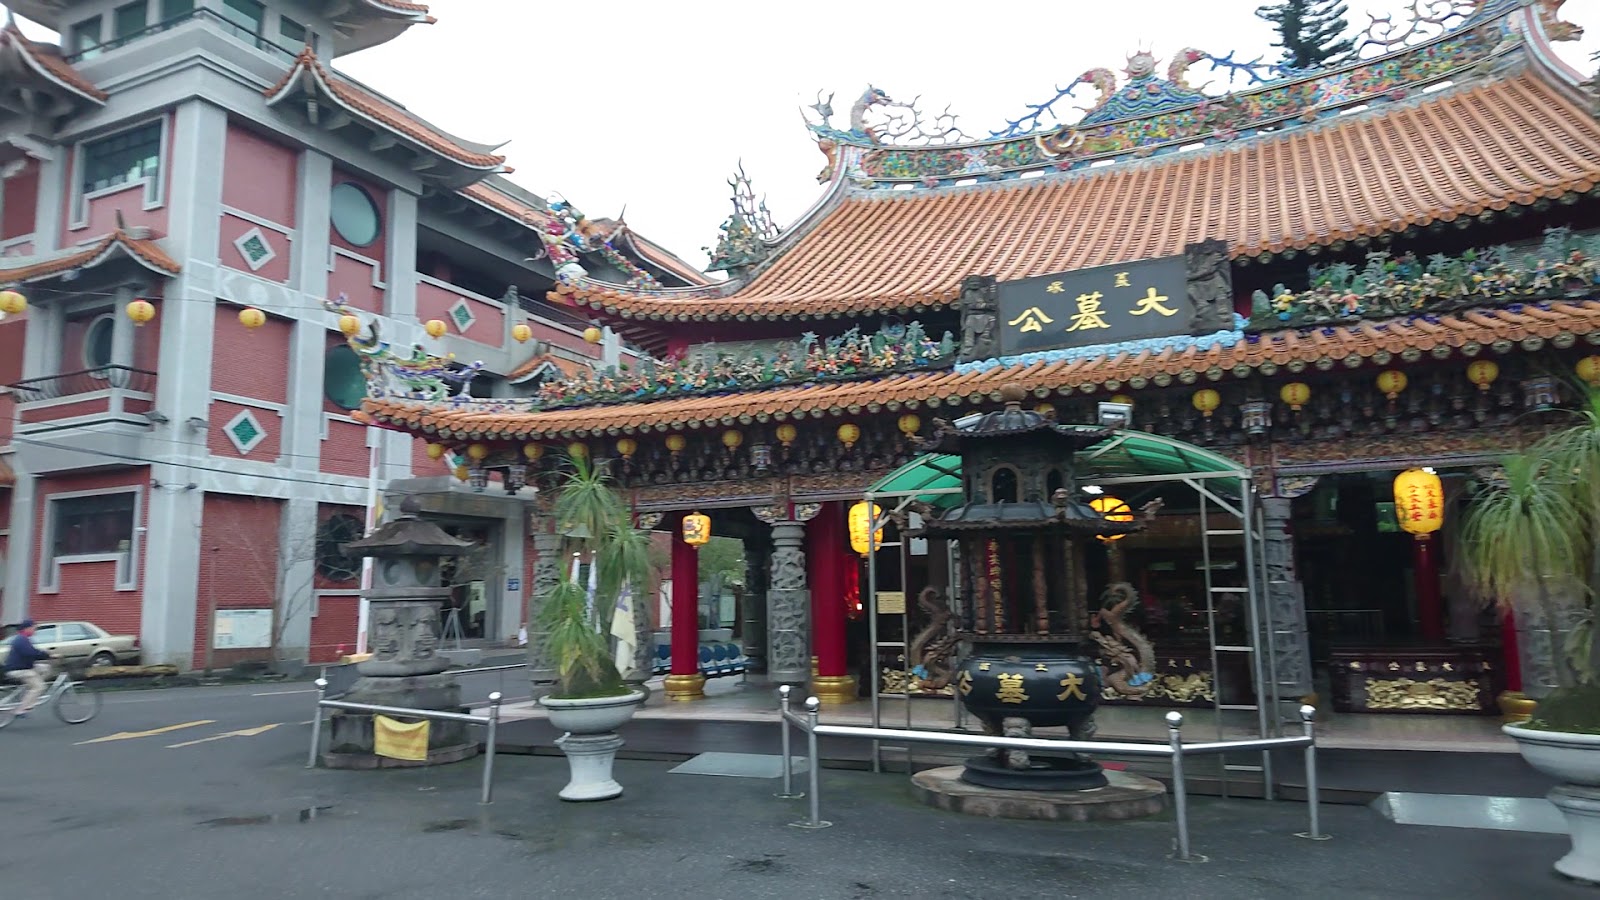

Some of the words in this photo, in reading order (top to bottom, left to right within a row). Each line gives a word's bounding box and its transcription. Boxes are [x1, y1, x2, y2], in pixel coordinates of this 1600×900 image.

[1008, 287, 1179, 333] 大墓公
[957, 672, 1087, 703] 大墓公
